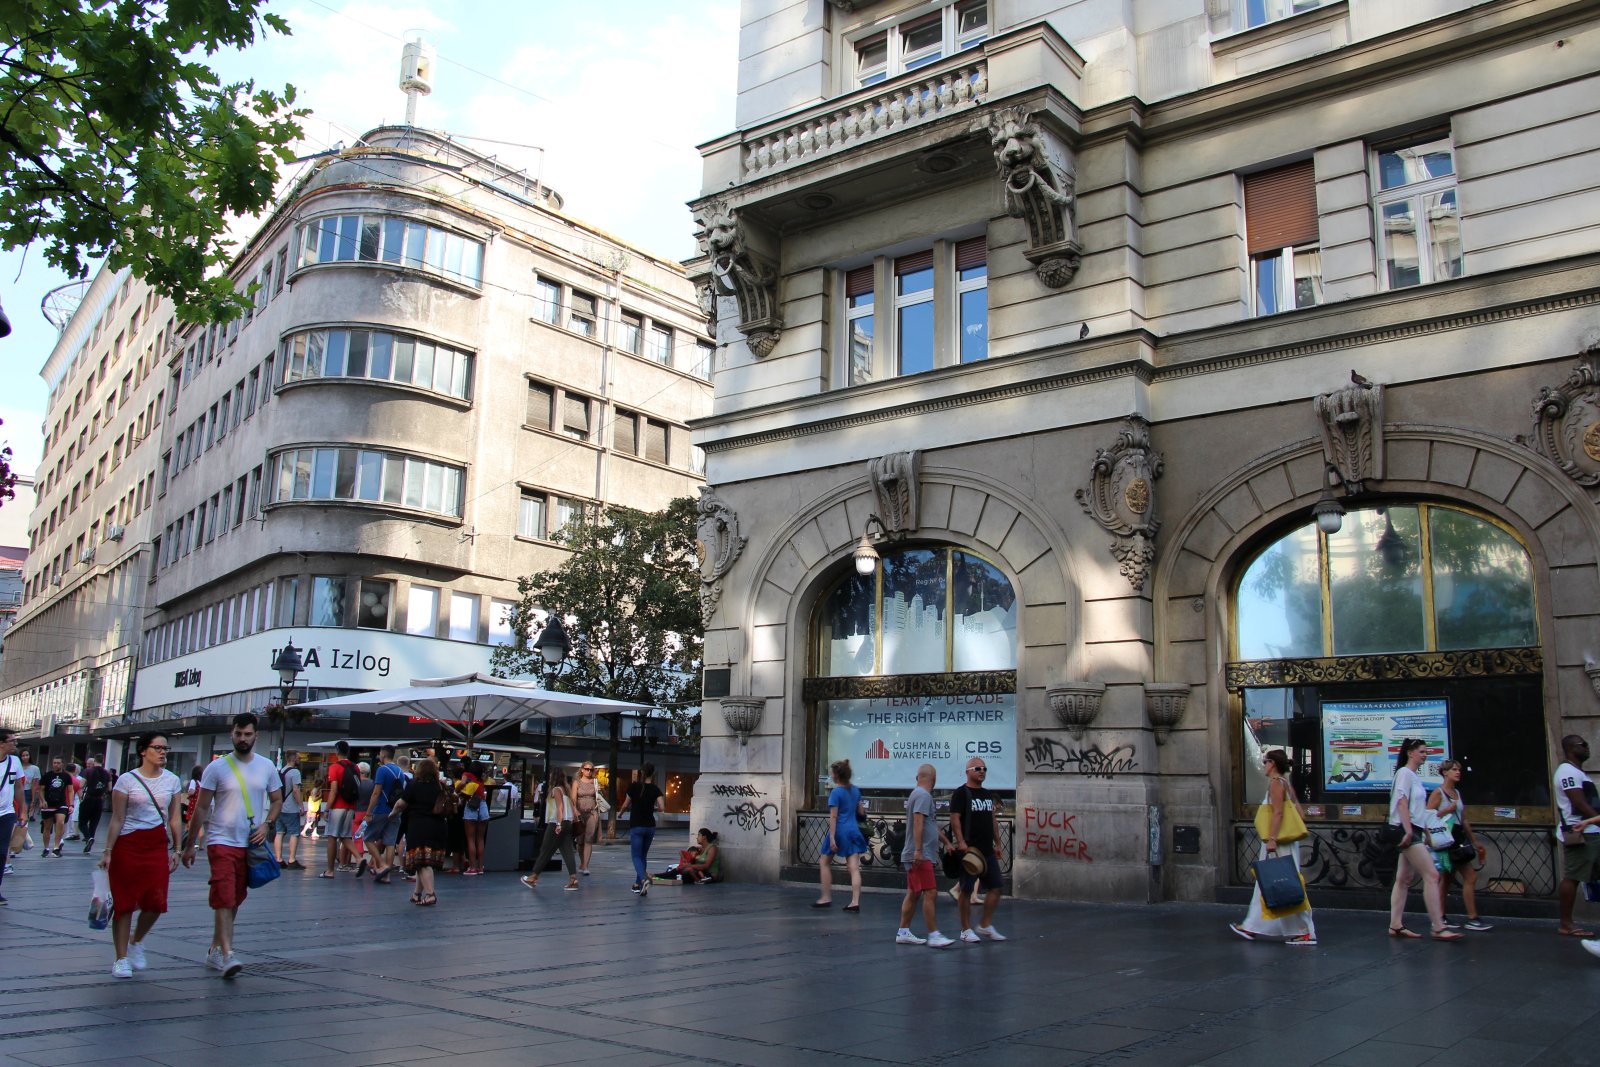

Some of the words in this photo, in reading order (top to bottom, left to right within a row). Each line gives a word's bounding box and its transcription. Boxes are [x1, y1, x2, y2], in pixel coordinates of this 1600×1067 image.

[272, 648, 320, 668] IA
[331, 648, 391, 677] Izlog
[946, 694, 1004, 705] DECADE
[867, 712, 892, 724] THE
[939, 710, 1004, 722] PARTNER
[892, 741, 941, 750] CUSHMAN
[943, 741, 951, 750] &
[965, 741, 1002, 753] CBS
[892, 751, 951, 759] WAKEFIELD
[1561, 776, 1575, 788] 86
[1024, 807, 1076, 835] FUCK
[1024, 832, 1093, 863] FENER
